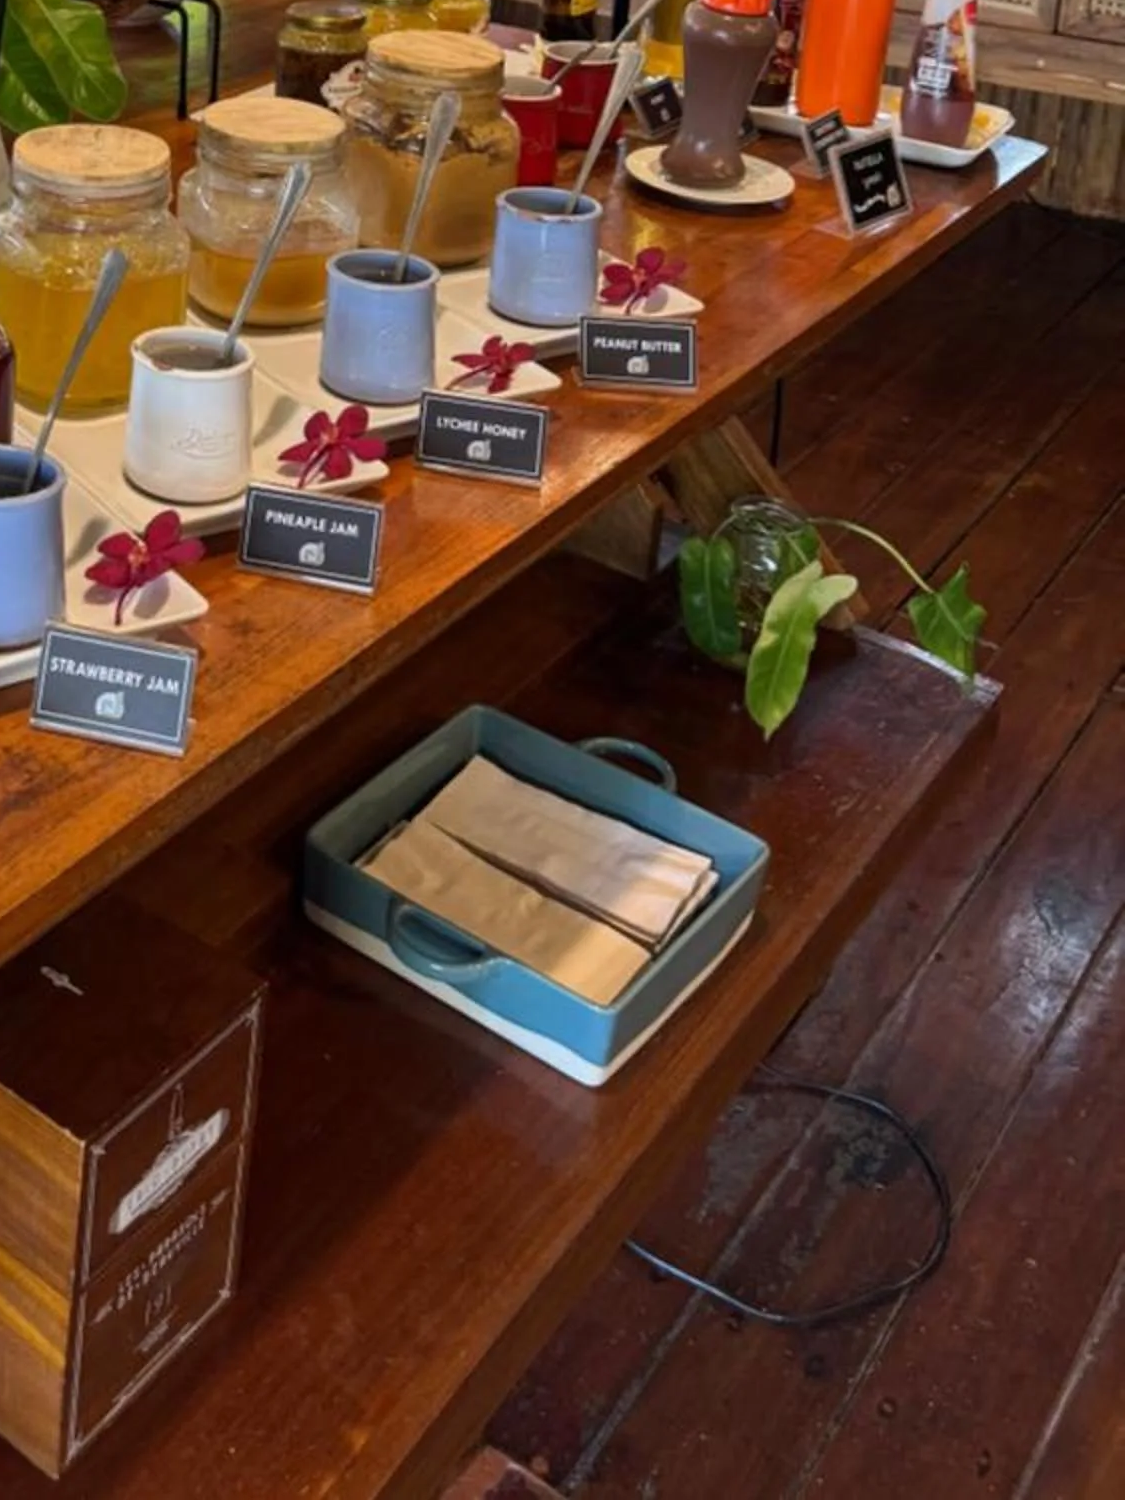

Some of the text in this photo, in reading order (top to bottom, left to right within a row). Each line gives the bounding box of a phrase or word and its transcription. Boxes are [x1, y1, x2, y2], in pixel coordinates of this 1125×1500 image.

[593, 336, 682, 354] PEANUT BUTTER
[436, 415, 527, 440] LYCHEE HONEY
[330, 520, 359, 537] JAM
[49, 656, 180, 695] STRAWBERRY JAM
